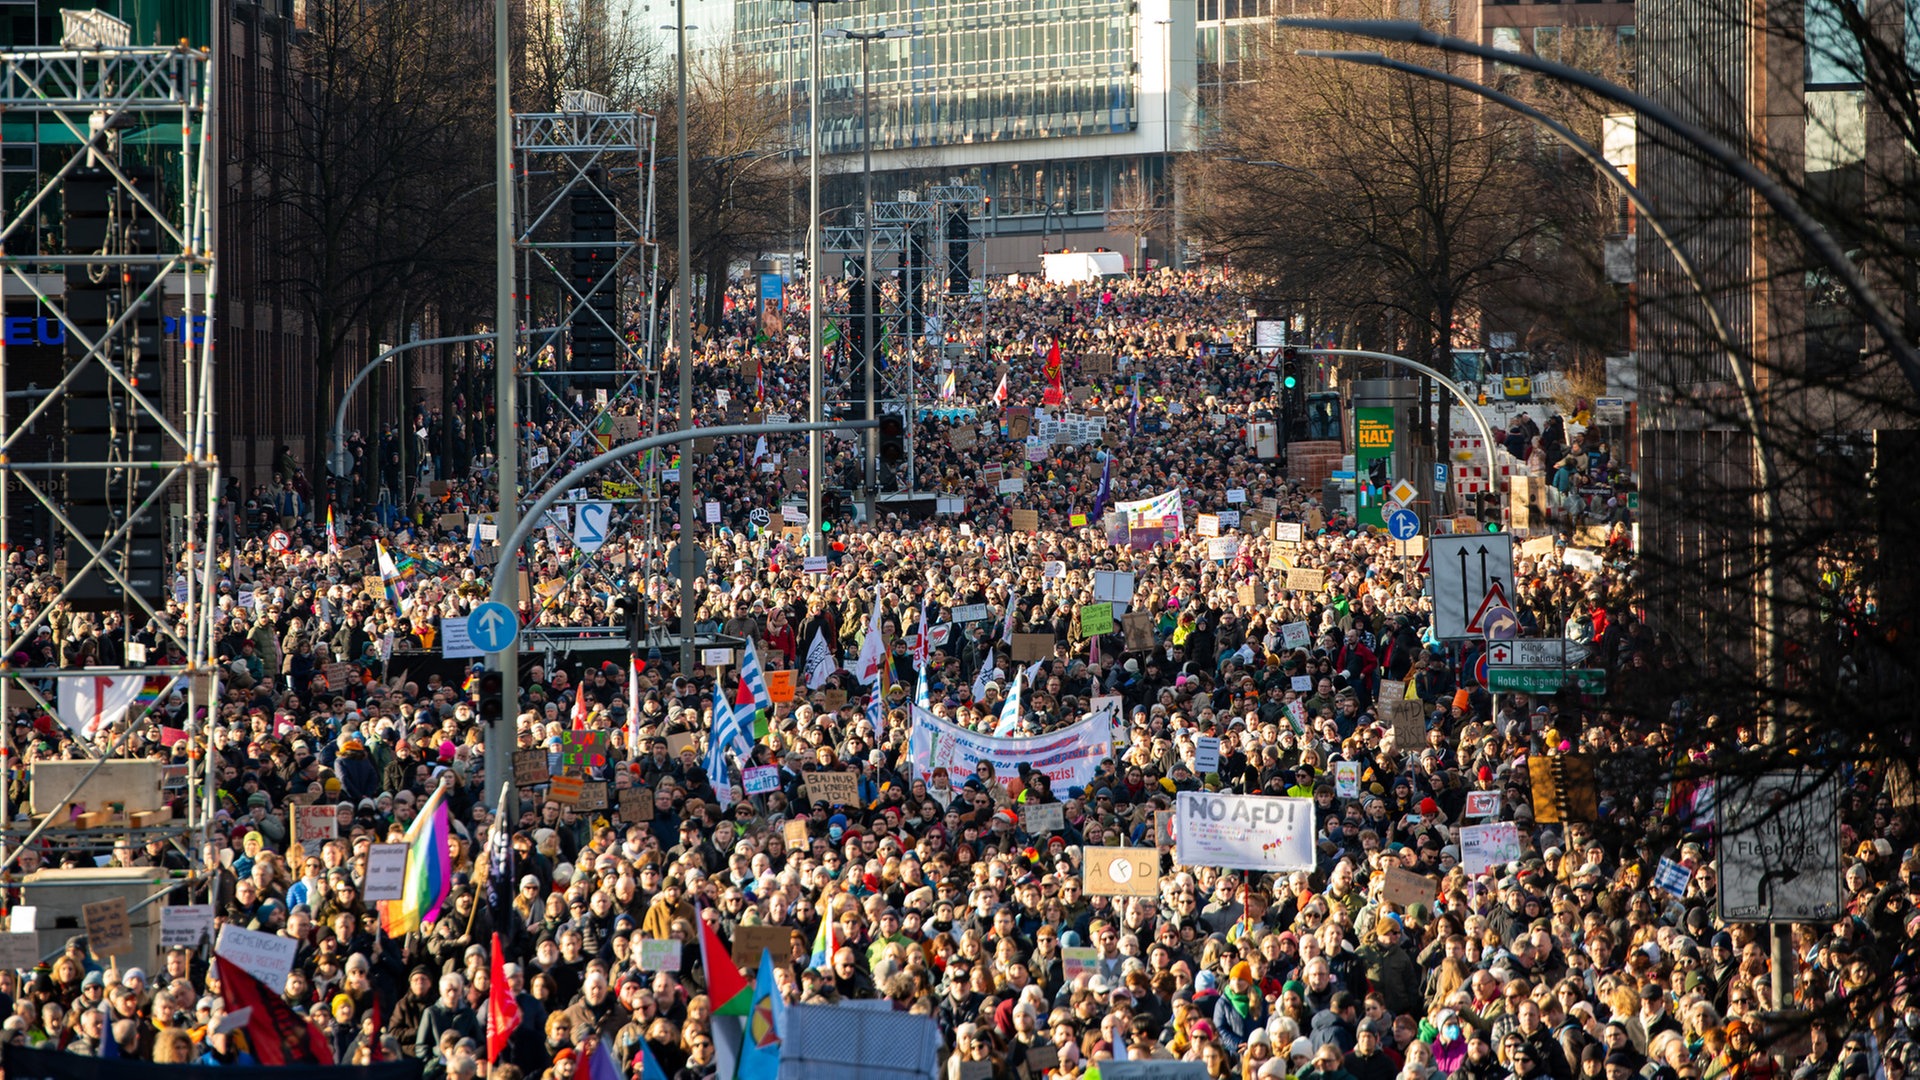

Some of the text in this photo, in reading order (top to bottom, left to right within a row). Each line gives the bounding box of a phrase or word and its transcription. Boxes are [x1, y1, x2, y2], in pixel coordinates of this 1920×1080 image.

[5, 315, 206, 346] EUPE
[1359, 429, 1395, 443] HALT
[1436, 465, 1444, 479] P
[1520, 643, 1545, 652] Klinik
[1520, 653, 1565, 662] Fleetinse
[1497, 676, 1519, 686] Hotel
[562, 731, 606, 745] BUNT
[563, 753, 606, 767] GESUND
[964, 753, 1011, 770] SONERN
[807, 774, 853, 785] BLAU NUR
[811, 784, 857, 794] IN KNEIPE
[826, 791, 851, 802] TOLL!
[1189, 796, 1227, 821] NO
[1089, 861, 1103, 878] A
[1138, 861, 1152, 878] D
